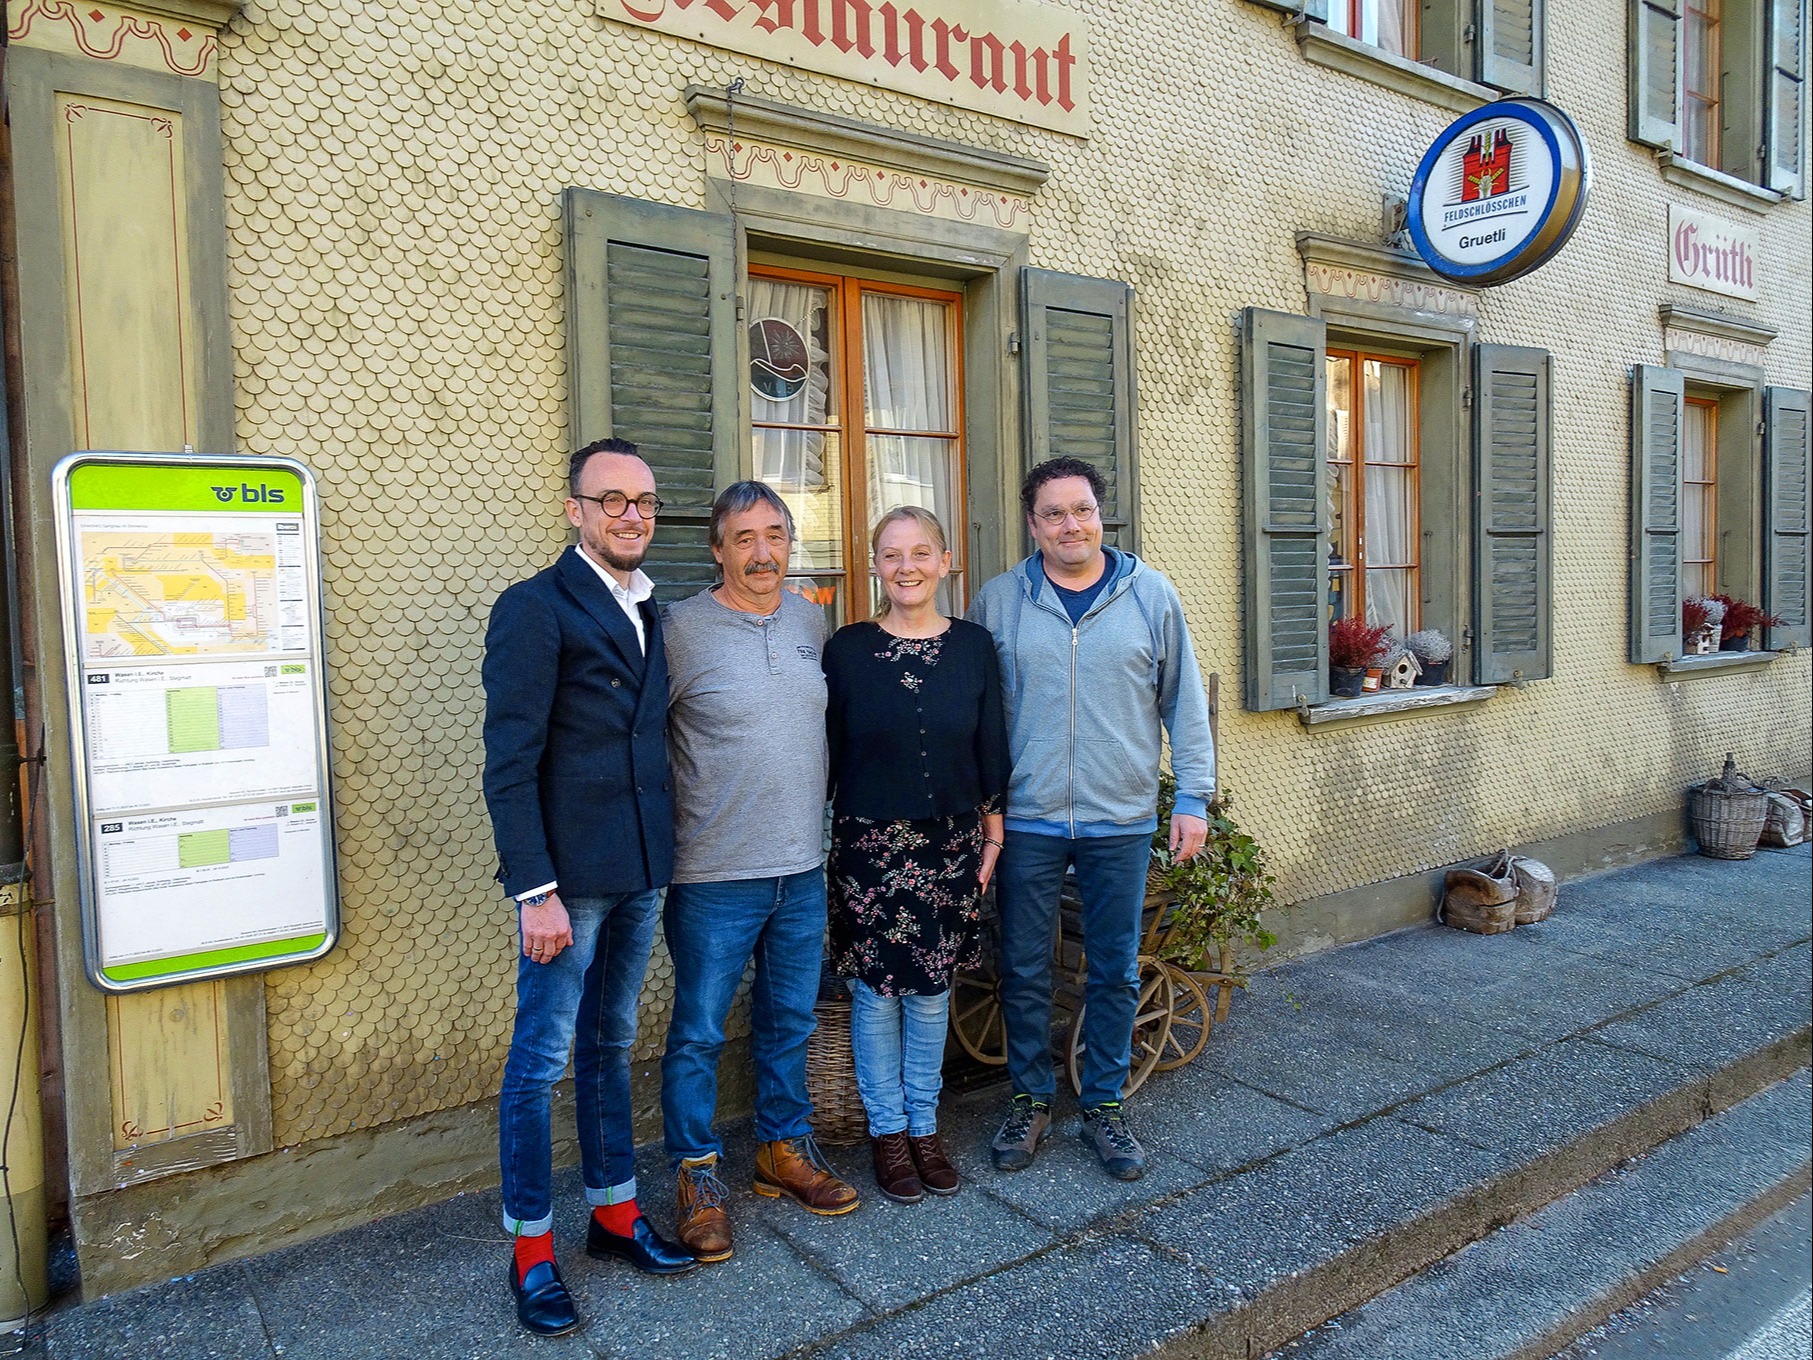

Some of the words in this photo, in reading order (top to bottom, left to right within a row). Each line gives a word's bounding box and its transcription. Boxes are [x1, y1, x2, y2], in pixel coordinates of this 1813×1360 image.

[621, 0, 1076, 113] staurant
[1444, 194, 1527, 223] FELDSCHLÖSSCHEN
[1459, 228, 1506, 249] Gruetli
[1674, 219, 1753, 289] Grütli
[241, 483, 285, 503] bls
[90, 675, 106, 683] 481
[103, 823, 120, 832] 285
